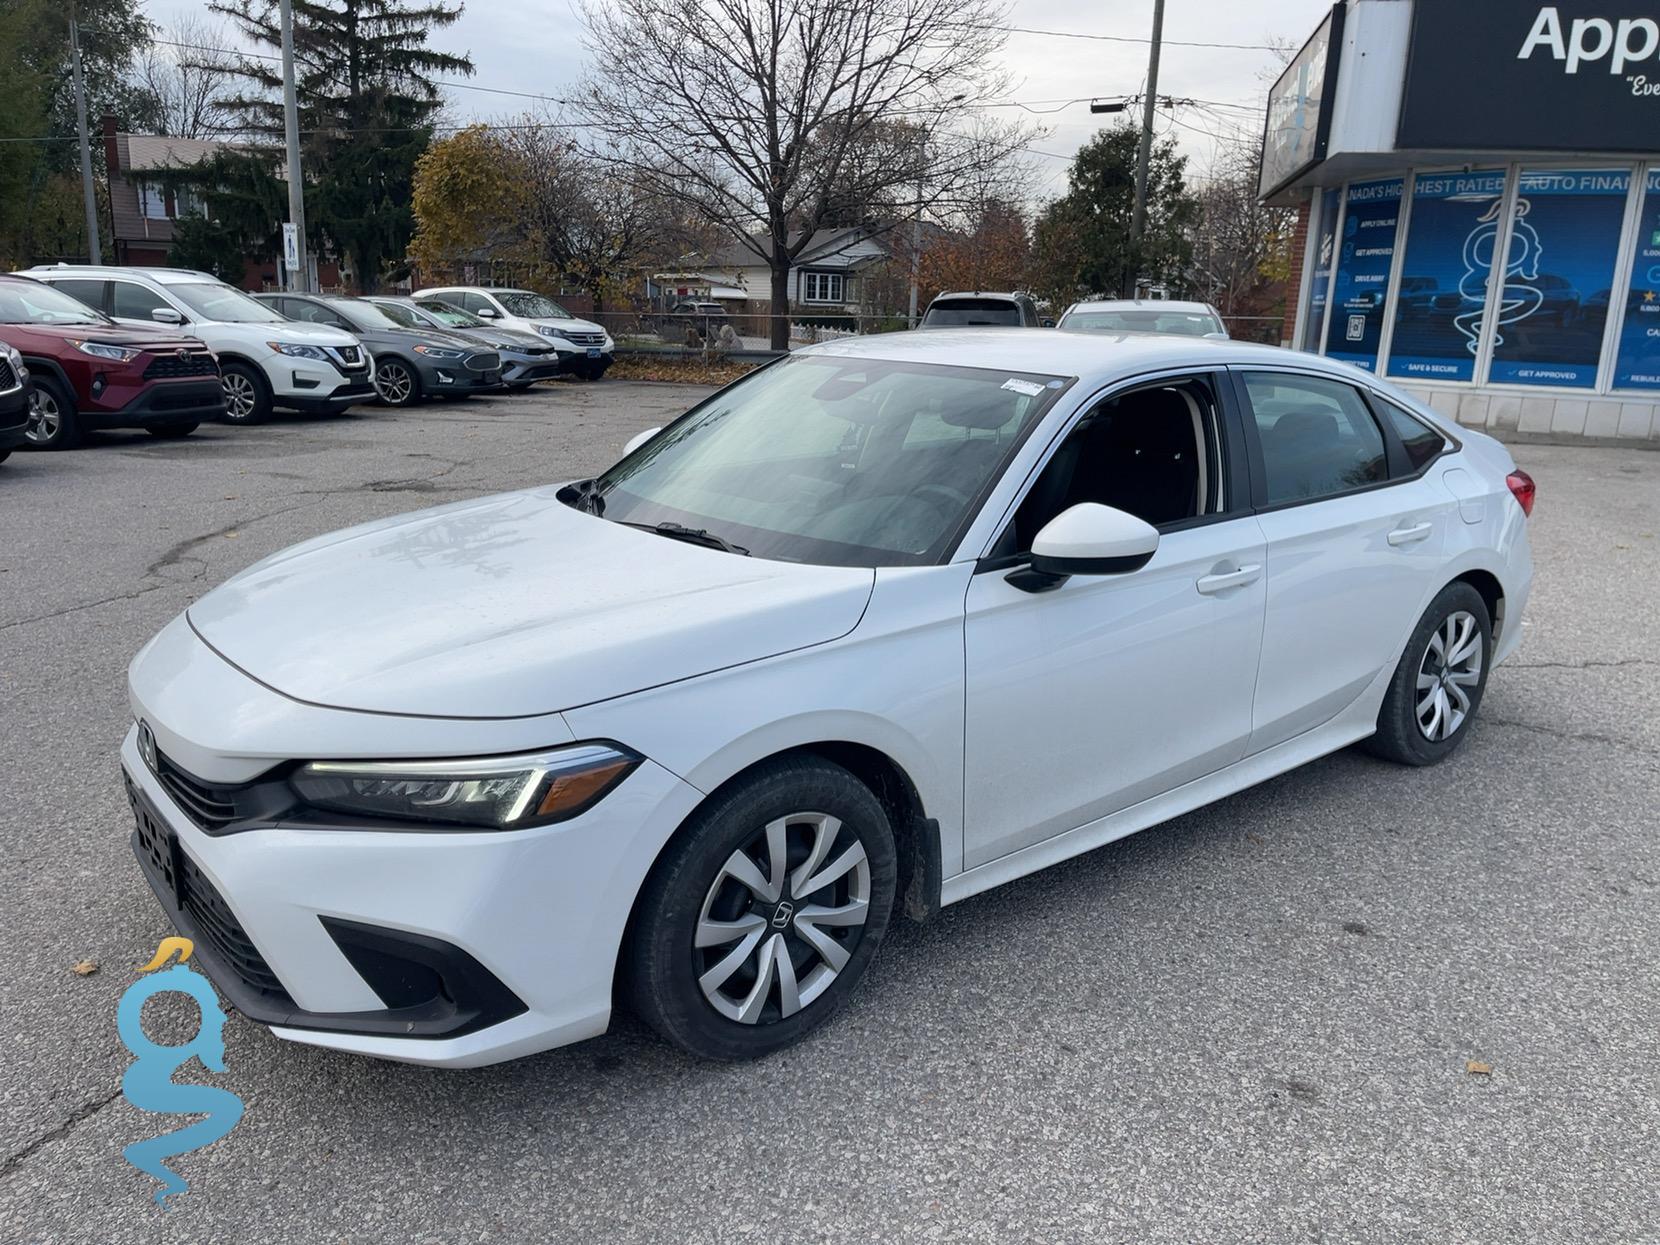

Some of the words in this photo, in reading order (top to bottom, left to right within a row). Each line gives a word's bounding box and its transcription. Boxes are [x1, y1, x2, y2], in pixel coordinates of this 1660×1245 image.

[1517, 7, 1659, 74] App
[1524, 176, 1576, 190] AUTO
[1408, 363, 1425, 372] SAFE
[1518, 369, 1534, 377] GET
[1534, 370, 1577, 380] APPROVED
